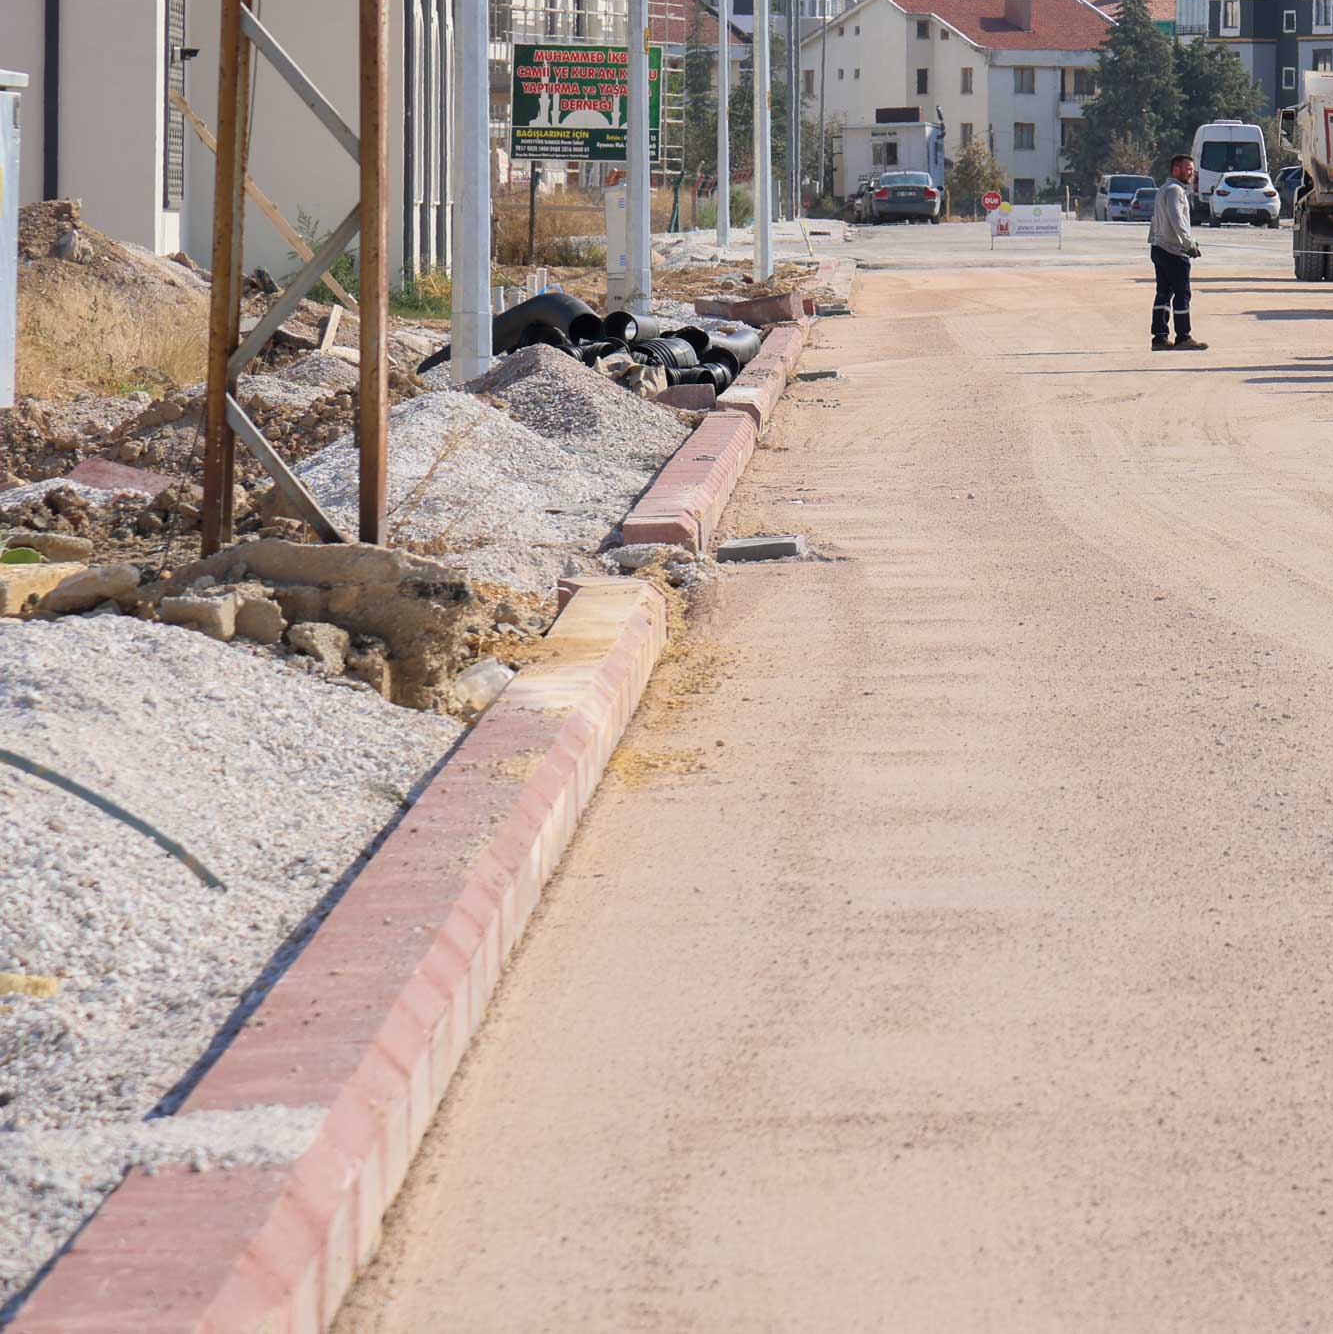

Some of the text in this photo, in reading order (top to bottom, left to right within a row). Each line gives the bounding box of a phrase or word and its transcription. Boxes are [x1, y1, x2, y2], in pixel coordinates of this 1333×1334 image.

[534, 48, 629, 63] MUHAMMED İKB
[553, 66, 569, 78] VE
[571, 66, 616, 79] KUR'AN
[522, 82, 580, 94] YAPTIRMA
[582, 85, 597, 95] ve
[560, 97, 613, 112] DERNEĞİ
[516, 128, 590, 140] BAĞIŞLARINIZ İÇİN
